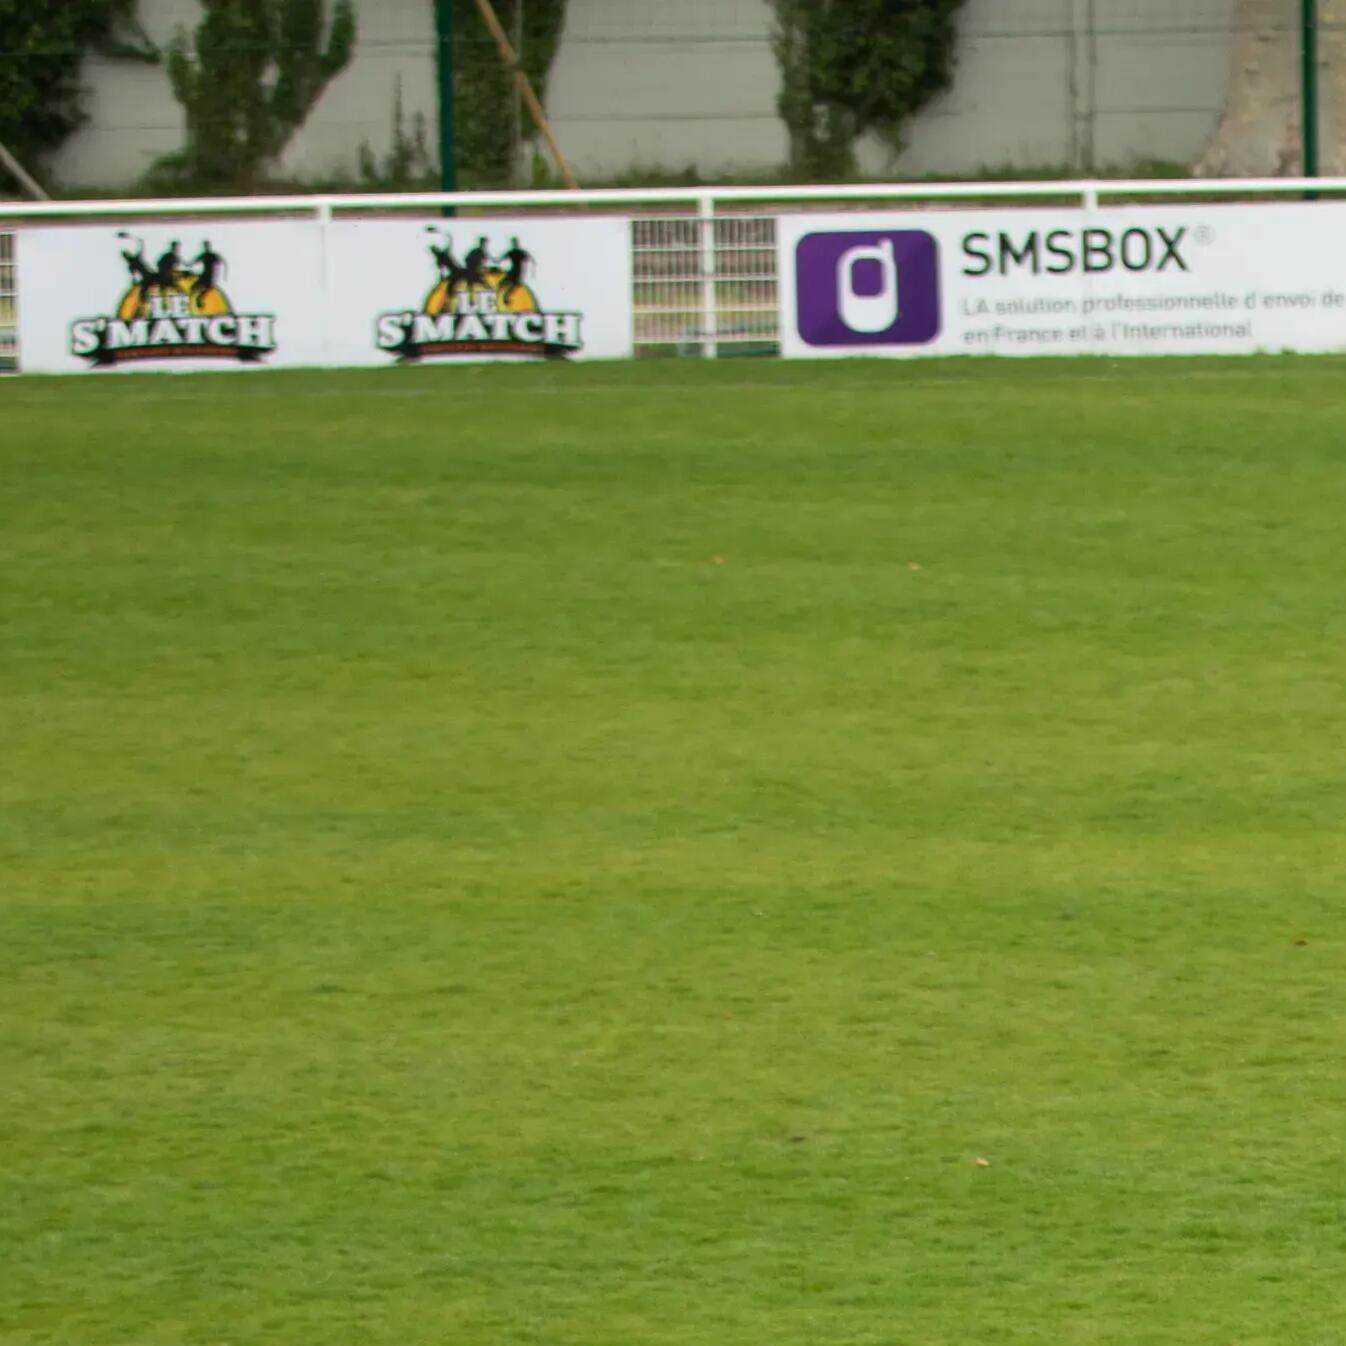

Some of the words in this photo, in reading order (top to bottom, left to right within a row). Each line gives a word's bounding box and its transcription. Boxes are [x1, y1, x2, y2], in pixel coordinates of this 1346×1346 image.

[151, 295, 190, 319] LE
[457, 290, 498, 314] LE
[962, 297, 990, 317] LA
[996, 296, 1077, 316] solution
[1082, 290, 1237, 317] professionnelle
[1321, 290, 1345, 308] de
[71, 315, 277, 355] S'MATCH
[378, 311, 584, 349] S'MATCH
[993, 327, 1064, 345] France
